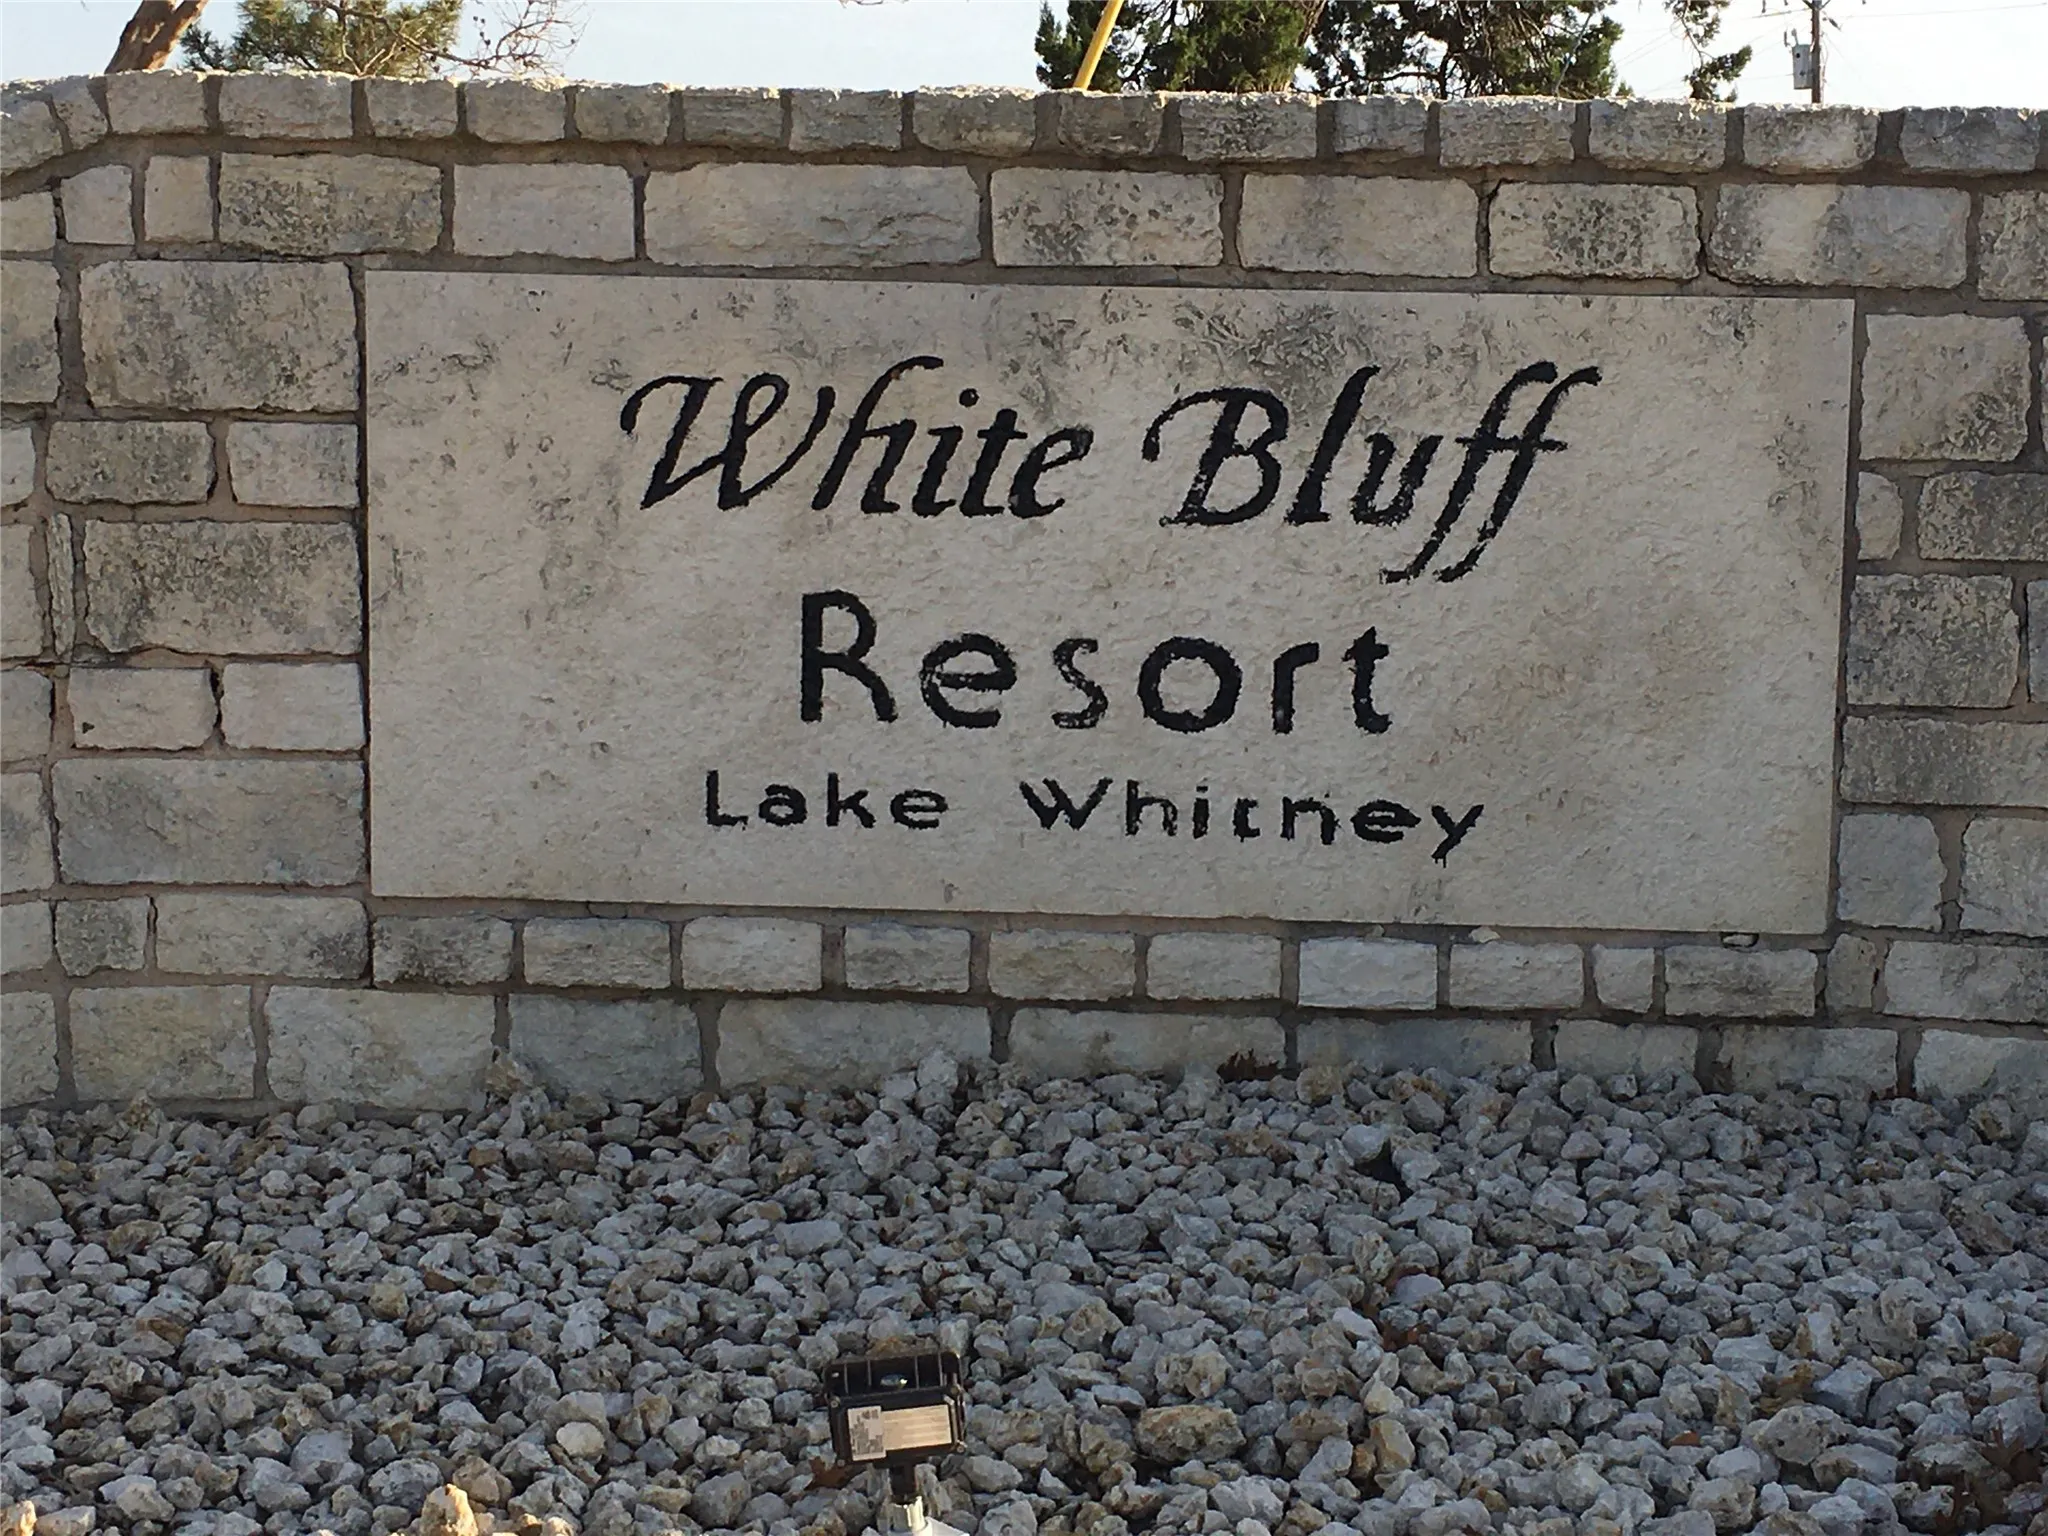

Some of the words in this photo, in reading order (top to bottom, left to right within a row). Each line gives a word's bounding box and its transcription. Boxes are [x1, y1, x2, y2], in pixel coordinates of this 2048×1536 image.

[620, 355, 1094, 520] White
[1142, 361, 1603, 585] Bluff
[800, 589, 1394, 736] Resort
[705, 769, 949, 831] Lake
